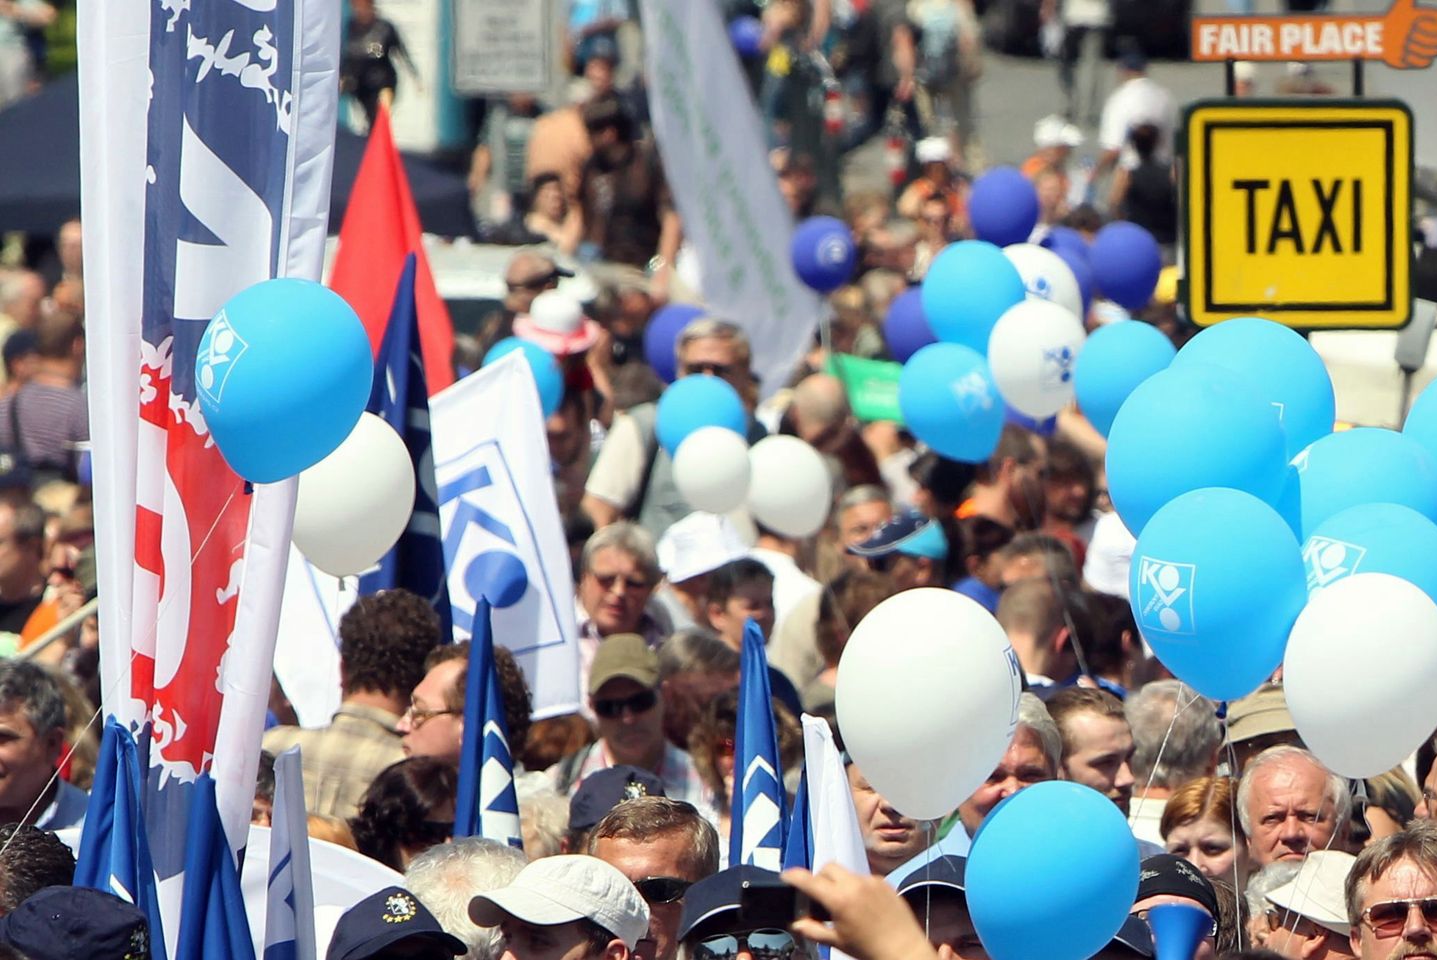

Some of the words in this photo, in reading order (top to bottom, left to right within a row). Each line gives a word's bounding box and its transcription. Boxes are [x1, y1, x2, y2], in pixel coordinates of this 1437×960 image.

[1200, 23, 1275, 55] FAIR
[1280, 22, 1384, 54] PLACE
[1232, 179, 1362, 255] TAXI
